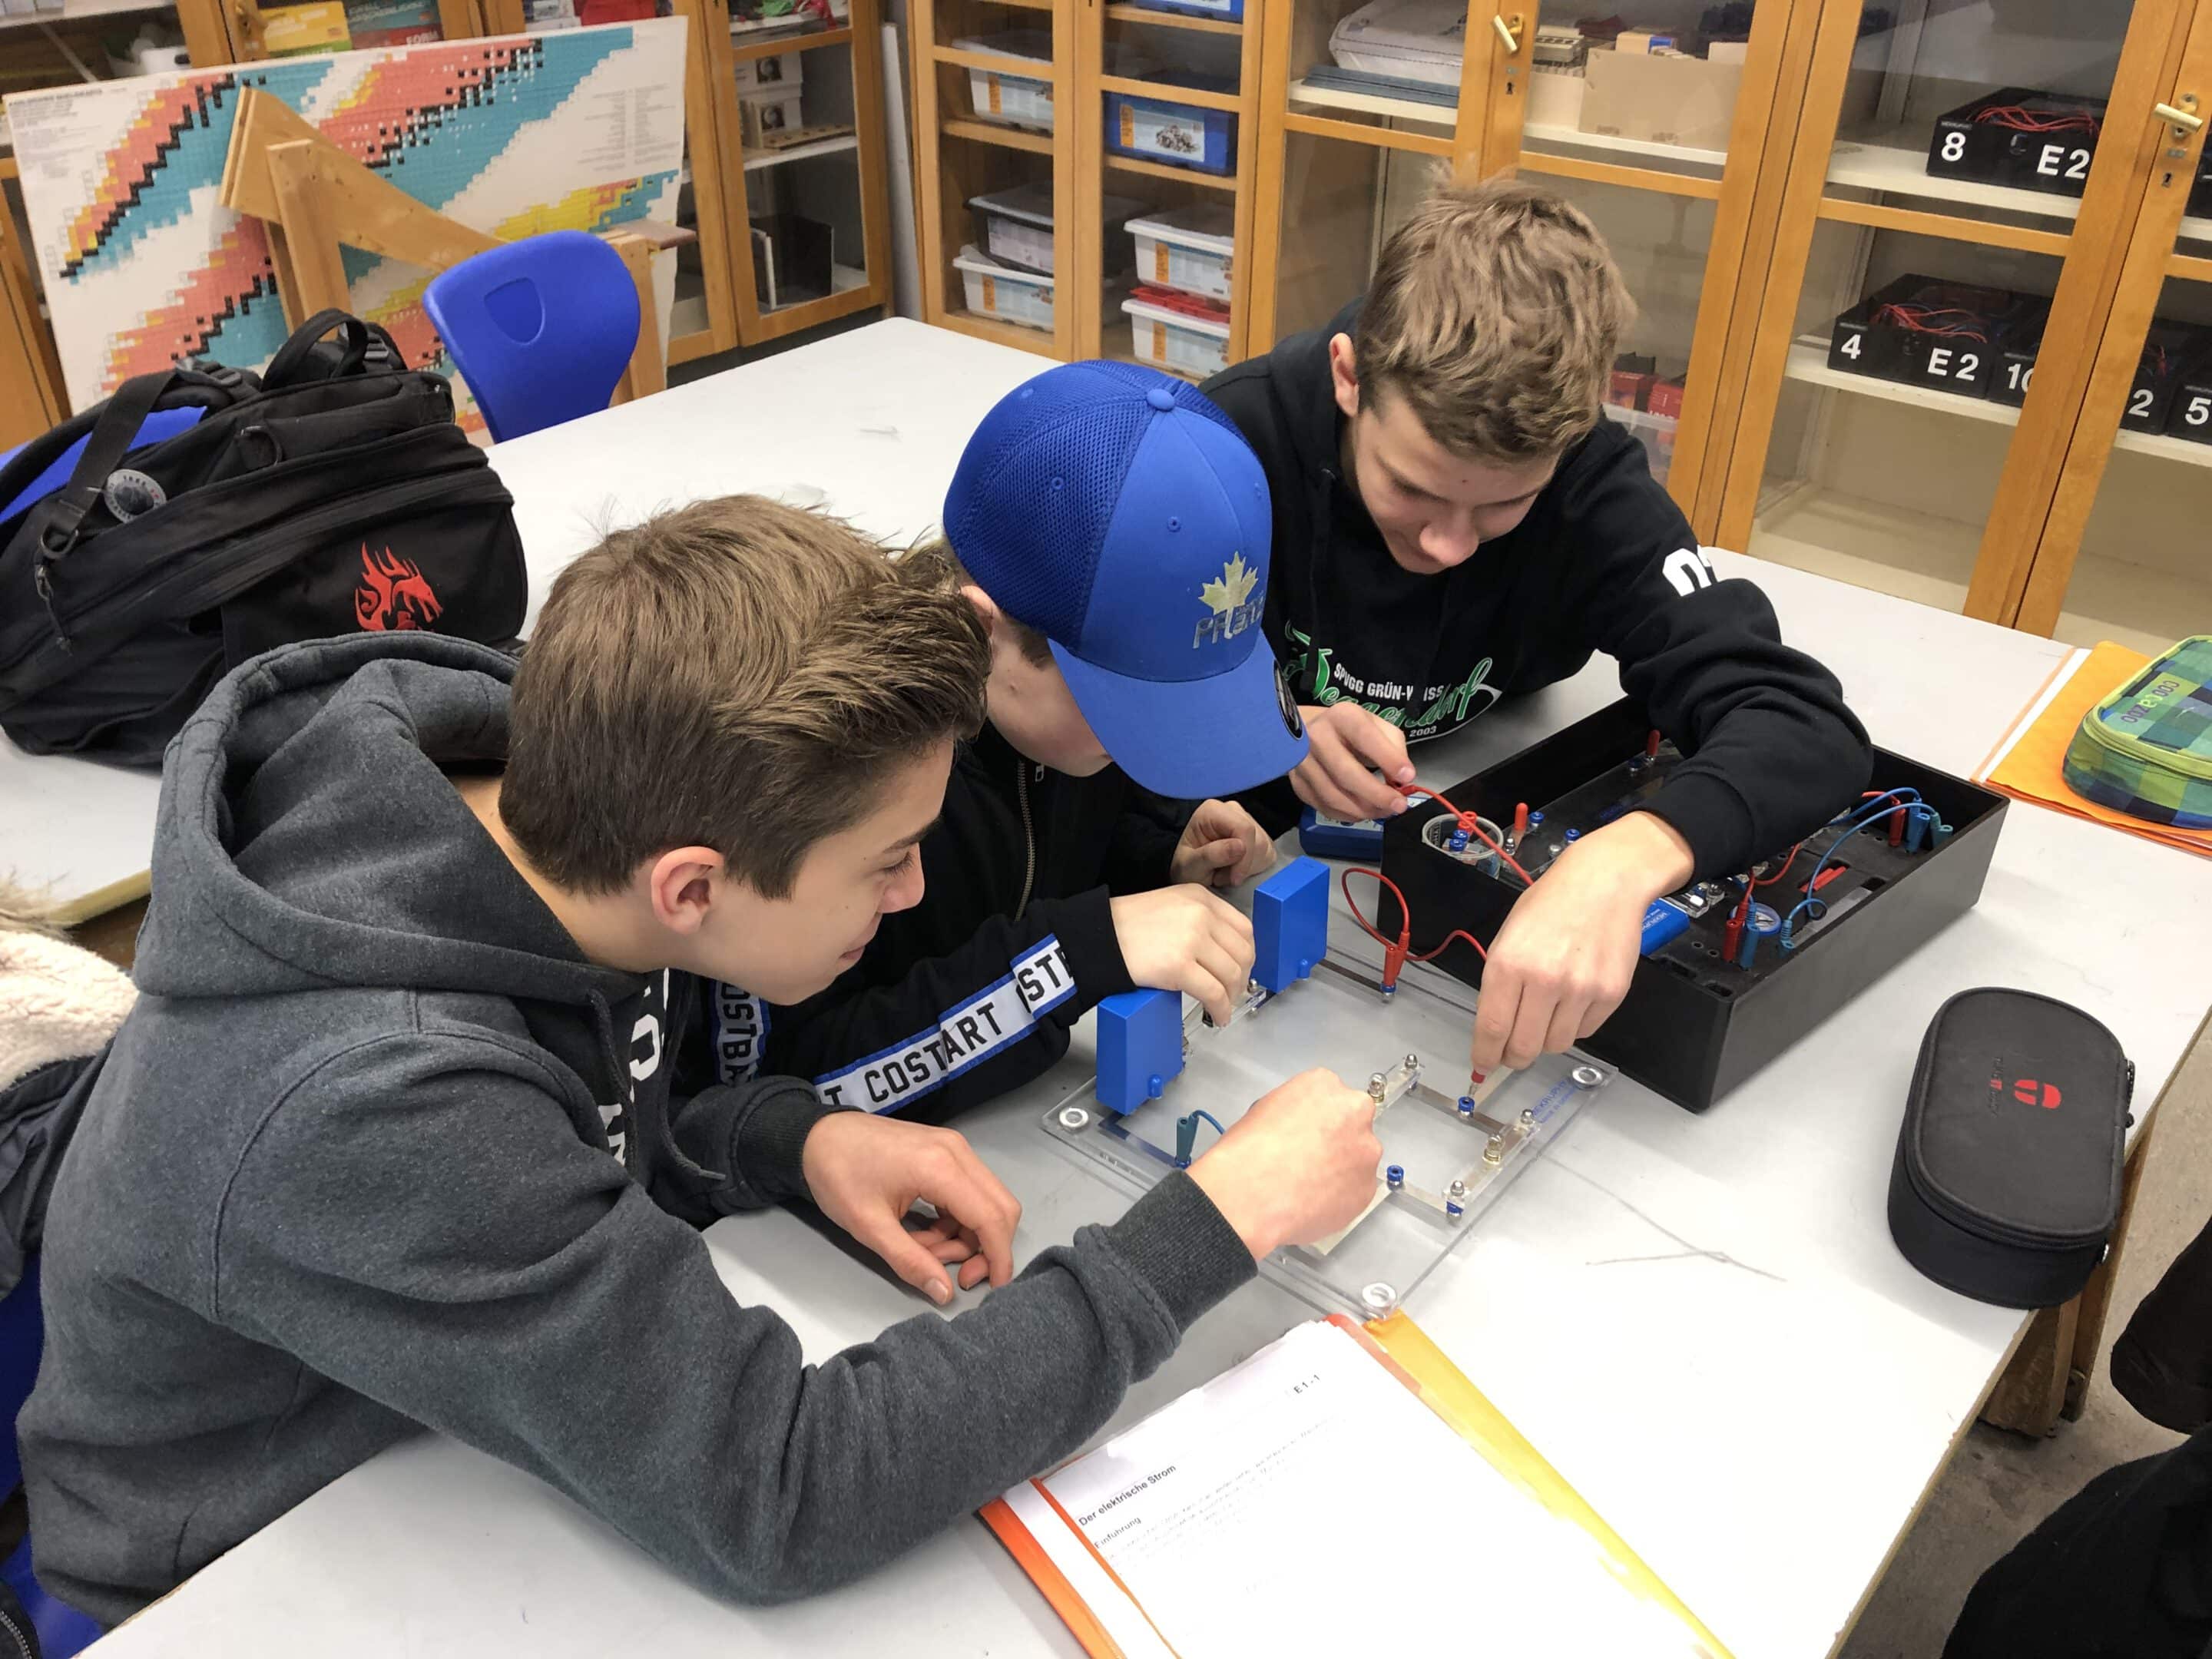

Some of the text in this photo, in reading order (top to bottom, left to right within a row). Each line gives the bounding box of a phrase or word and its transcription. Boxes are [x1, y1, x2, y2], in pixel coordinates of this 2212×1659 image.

[1941, 131, 1966, 161] 8
[1840, 333, 1862, 359] 4
[2128, 389, 2154, 418] 2
[2184, 396, 2212, 426] 5
[1333, 662, 1364, 694] SPVGG
[1409, 725, 1438, 737] 2003
[1078, 1465, 1177, 1527] Der elektrische Strom
